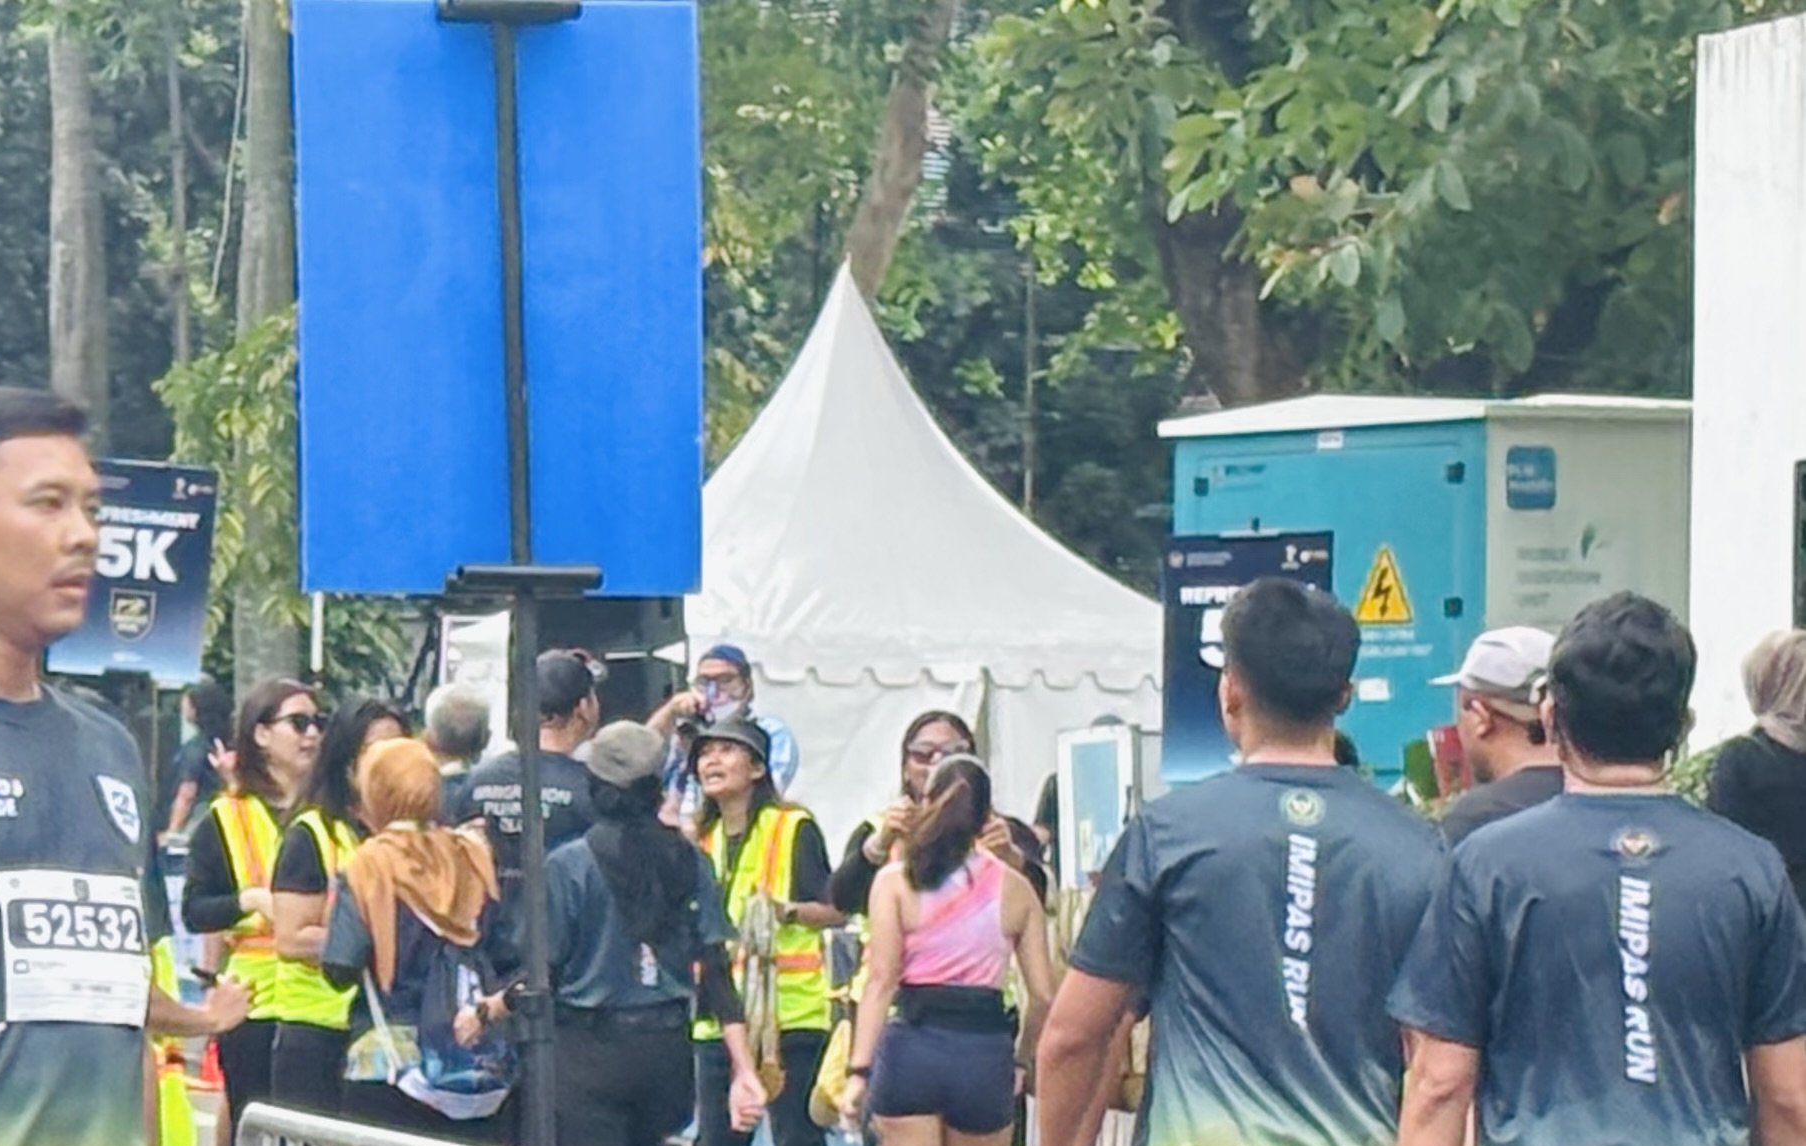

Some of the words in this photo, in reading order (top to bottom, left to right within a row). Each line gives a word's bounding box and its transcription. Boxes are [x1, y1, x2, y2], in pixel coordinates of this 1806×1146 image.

[95, 526, 179, 583] 5K
[22, 902, 142, 952] 52532
[1284, 833, 1318, 954] IMIPAS
[1618, 875, 1651, 1003] IMIPAS
[1624, 1005, 1657, 1084] RUN
